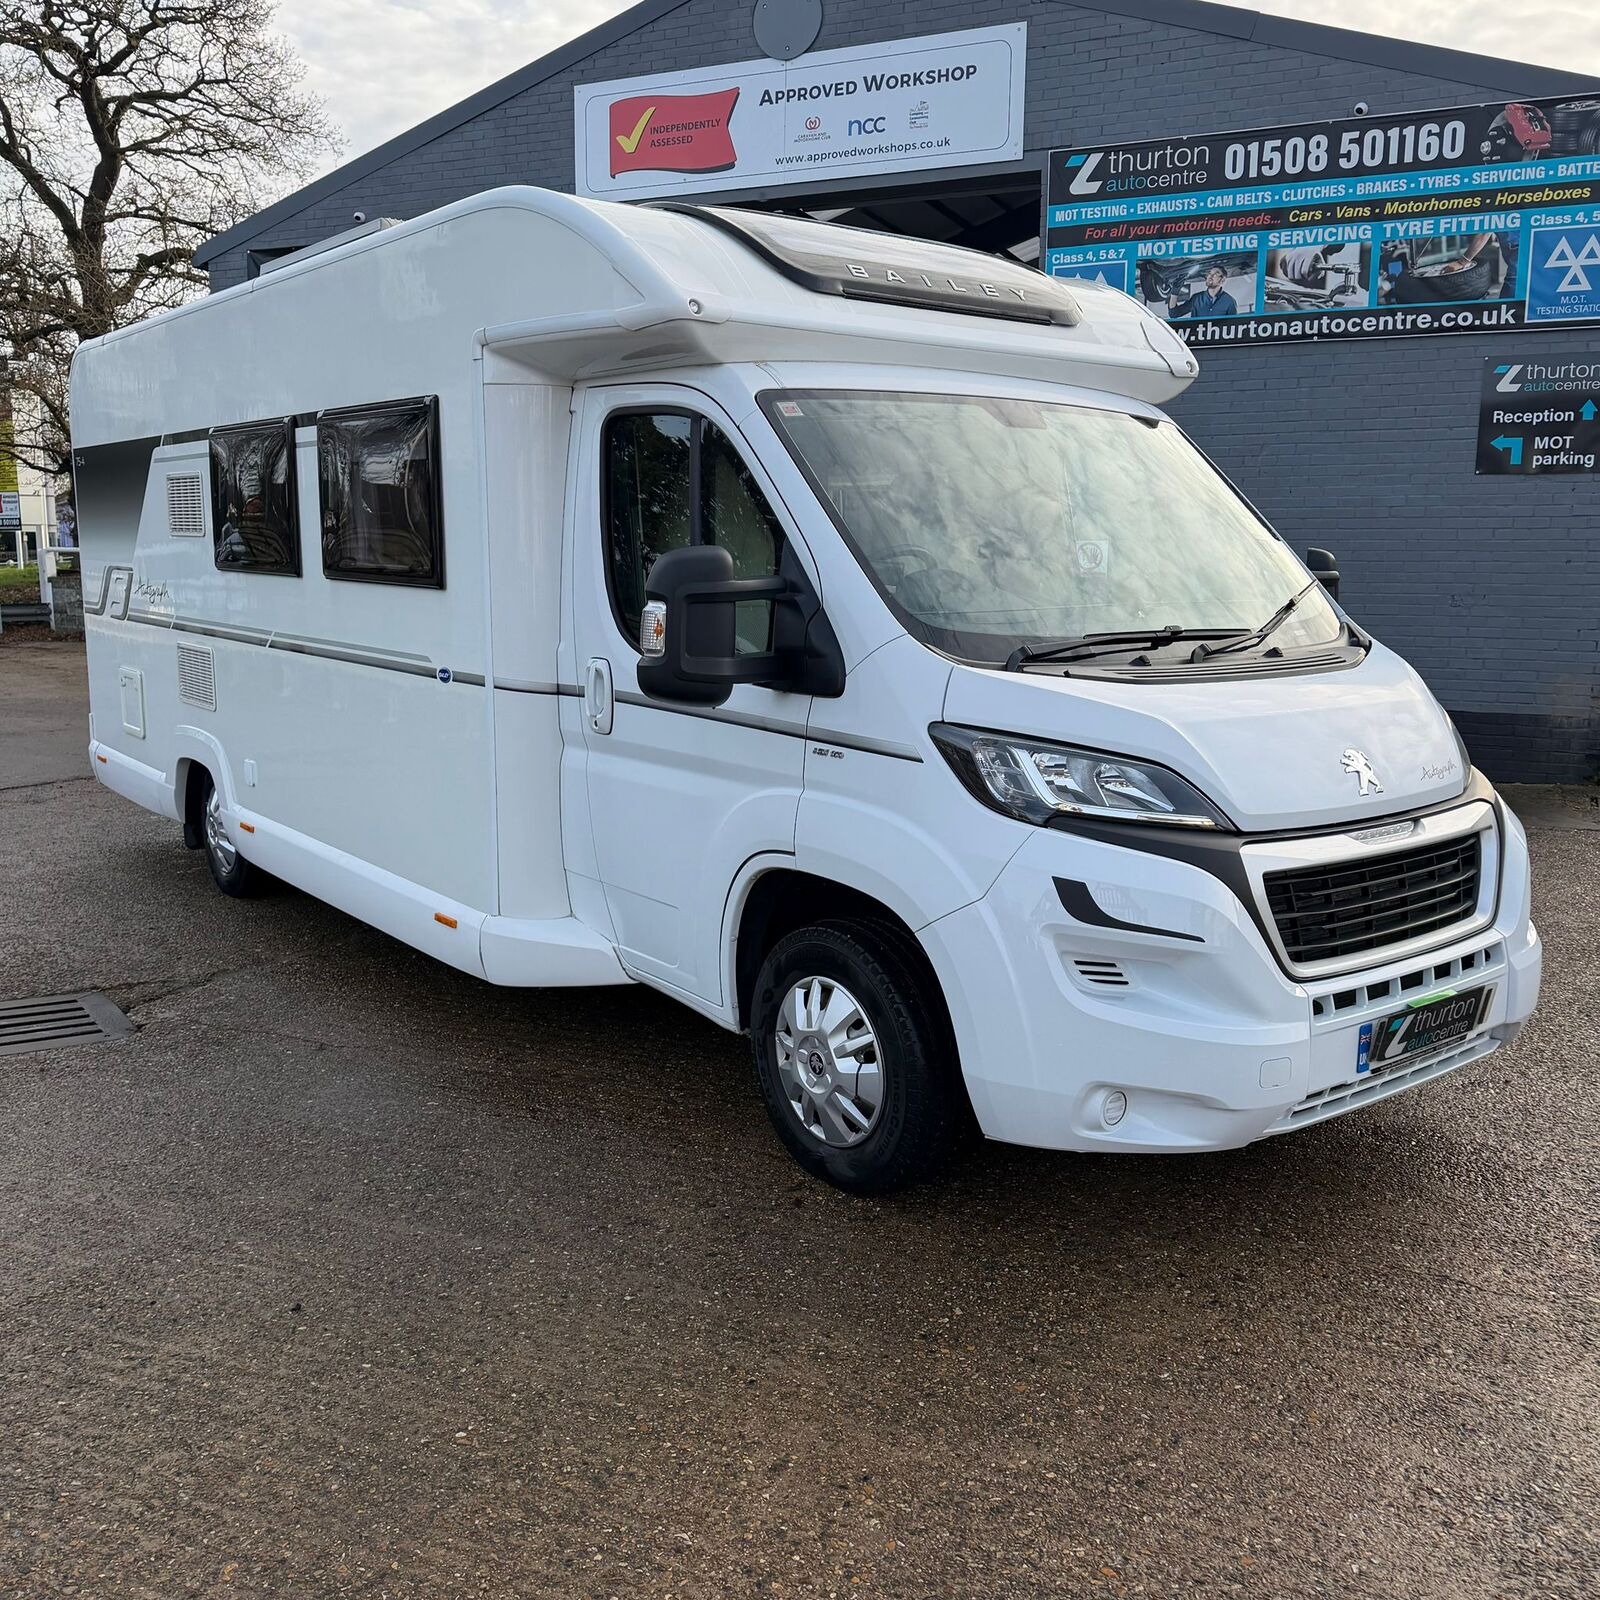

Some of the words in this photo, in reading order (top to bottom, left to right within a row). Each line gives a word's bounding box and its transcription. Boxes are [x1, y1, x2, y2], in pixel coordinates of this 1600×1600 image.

[759, 80, 858, 107] APPROVED
[863, 64, 978, 93] WORKSHOP
[650, 118, 721, 135] INDEPENDENTLY
[848, 116, 886, 136] ncc
[650, 135, 693, 148] ASSESSED
[775, 137, 951, 165] www.approvedworkshops.co.uk
[1224, 134, 1329, 180] 01508
[1339, 120, 1466, 169] 501160
[1108, 144, 1210, 174] thurton
[1106, 170, 1208, 192] autocentre
[1055, 210, 1078, 222] MOT
[1080, 204, 1127, 219] TESTING
[1137, 199, 1197, 215] EXHAUSTS
[1207, 195, 1233, 209] CAM
[1236, 191, 1272, 206] BELTS
[1282, 185, 1345, 202] CLUTCHES
[1356, 179, 1407, 195] BRAKES
[1418, 174, 1461, 189] TYRES
[1472, 165, 1545, 185] SERVICING
[1085, 226, 1107, 240] For
[1110, 223, 1126, 238] all
[1128, 223, 1160, 240] your
[1163, 216, 1225, 235] motoring
[1228, 212, 1281, 228] needs...
[1289, 209, 1322, 223] Cars
[1336, 206, 1371, 219] Vans
[1384, 195, 1481, 215] Motorhomes
[1495, 187, 1591, 206] Horseboxes
[1531, 213, 1571, 226] Class
[1575, 211, 1588, 224] 4,
[1268, 224, 1372, 247] SERVICING
[1383, 221, 1434, 238] TYRE
[1439, 213, 1521, 233] FITTING
[1138, 241, 1174, 257] MOT
[1180, 234, 1258, 253] TESTING
[1052, 251, 1084, 265] Class
[1086, 250, 1097, 263] 4,
[846, 264, 1026, 301] BAILEY
[1536, 305, 1571, 315] TESTING
[1561, 294, 1587, 304] M.O.T.
[1527, 363, 1600, 379] thurton
[1524, 380, 1600, 392] autocentre
[1493, 408, 1574, 425] Reception
[1534, 436, 1574, 449] MOT
[1532, 451, 1595, 468] parking
[1421, 758, 1456, 780] Autograph
[1415, 997, 1475, 1032] thurton
[1407, 1020, 1469, 1050] autocentre
